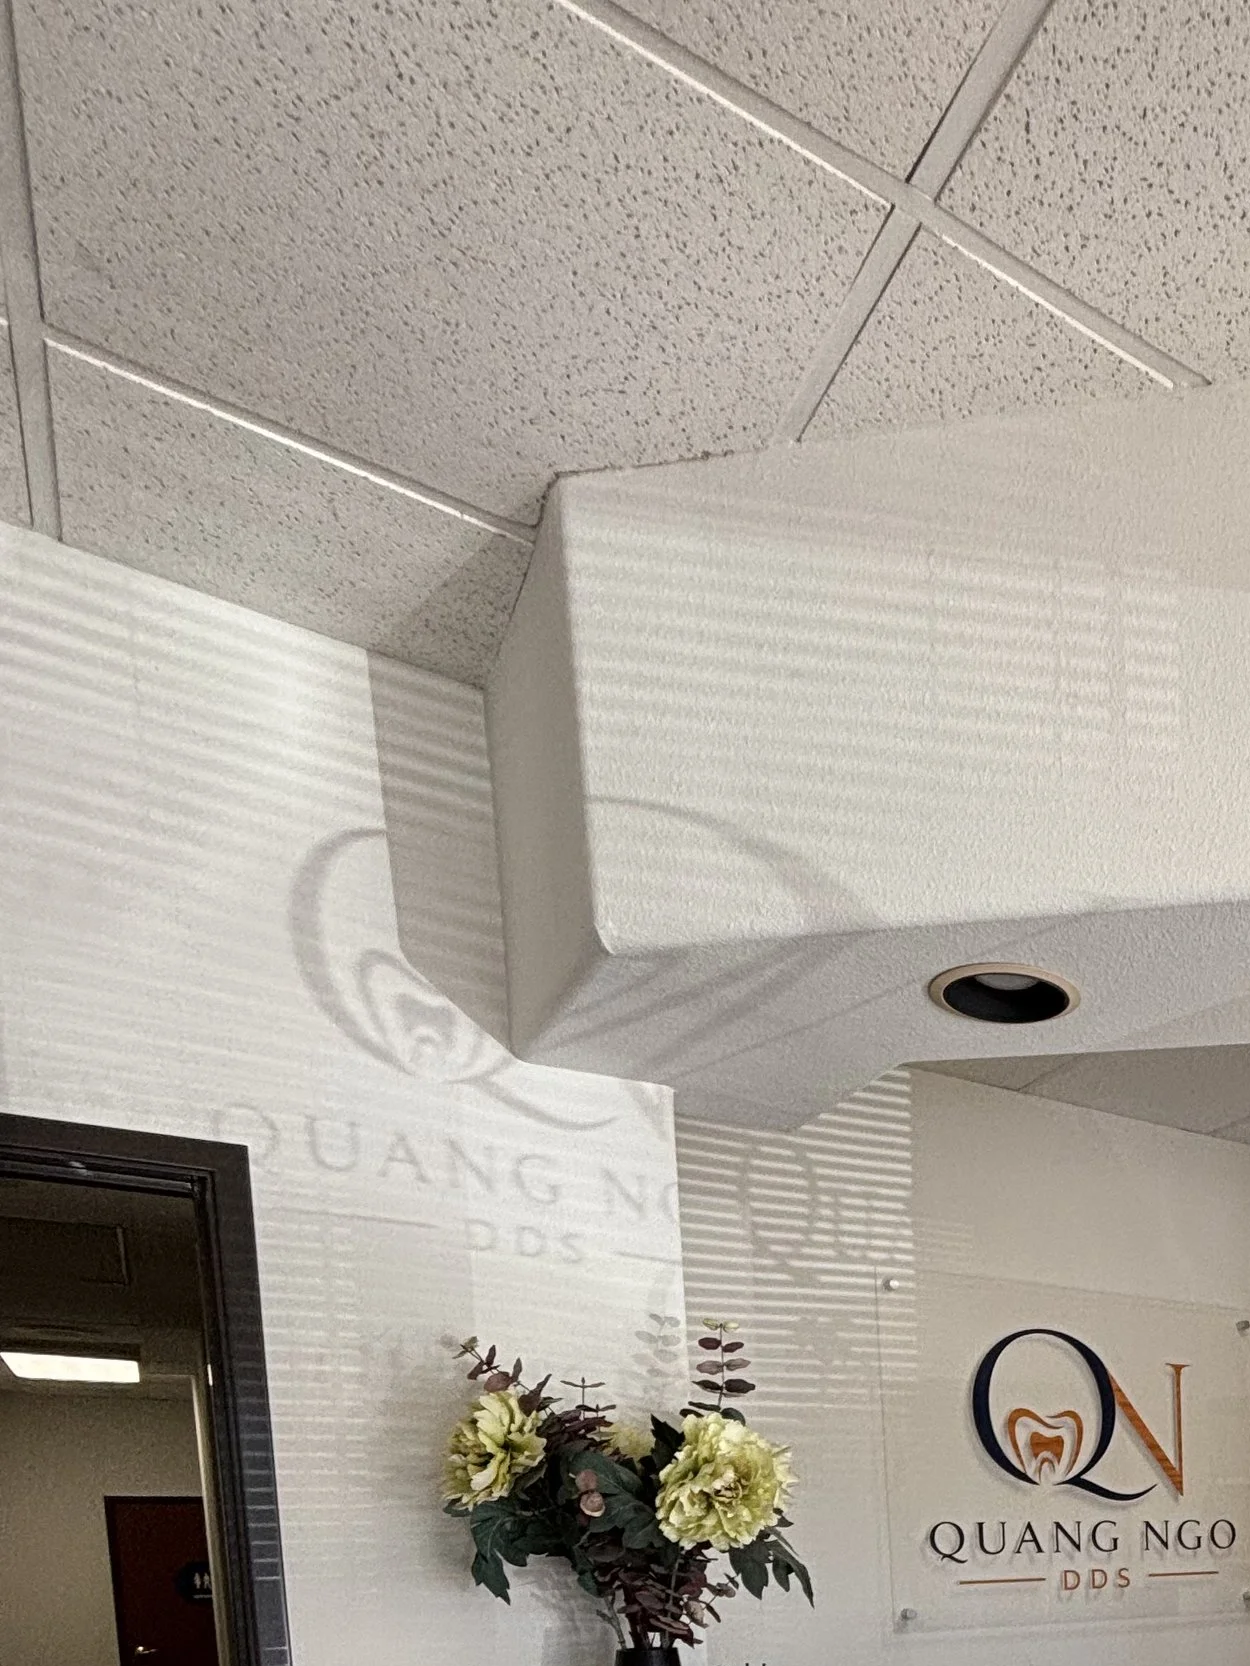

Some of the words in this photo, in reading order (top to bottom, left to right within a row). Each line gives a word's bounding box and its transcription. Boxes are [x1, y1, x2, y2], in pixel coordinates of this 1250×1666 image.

[929, 1520, 1119, 1564] QUANG
[1143, 1519, 1237, 1552] NGO
[1062, 1567, 1131, 1591] DDS
